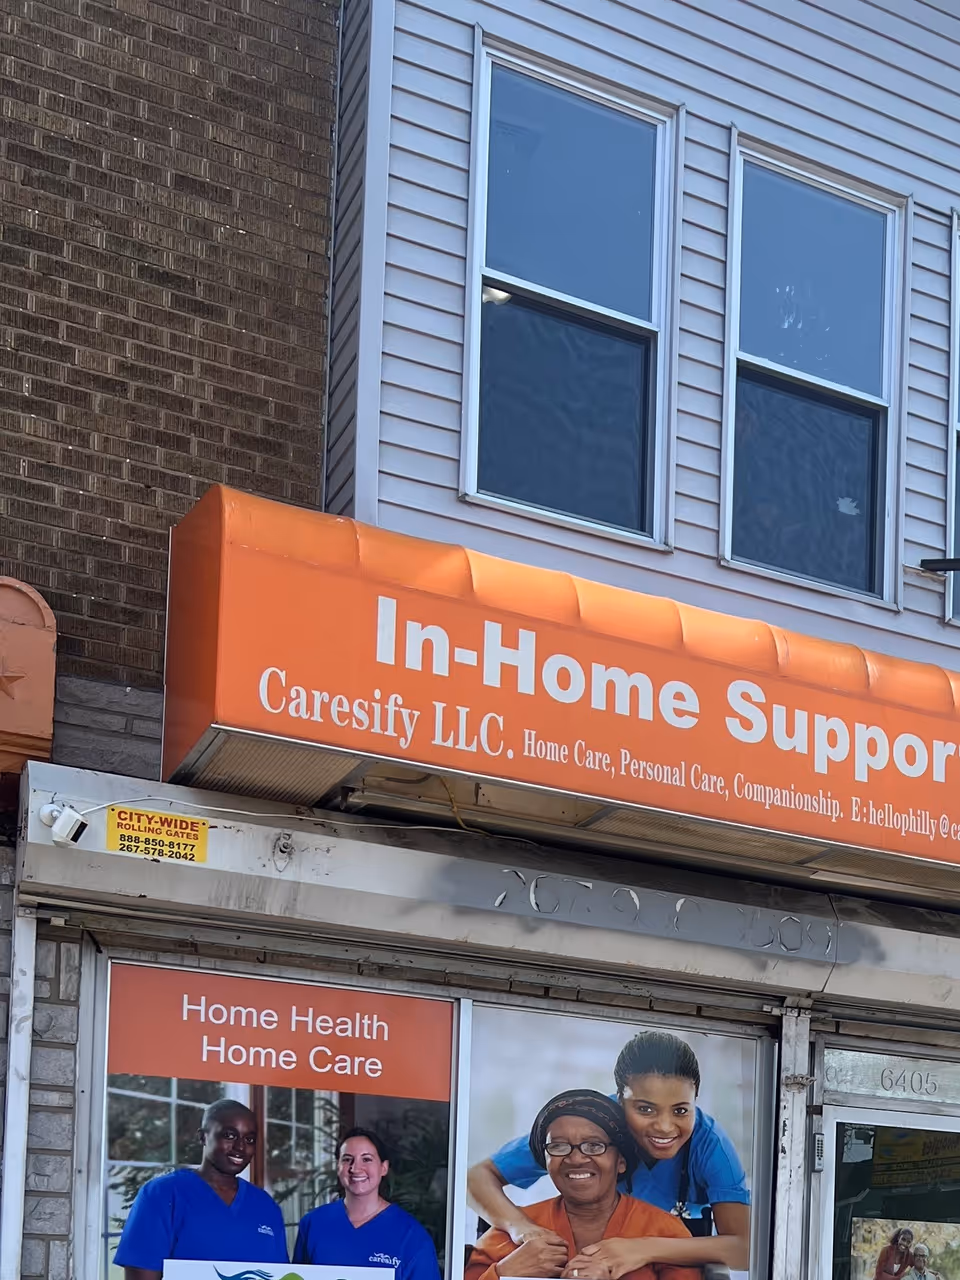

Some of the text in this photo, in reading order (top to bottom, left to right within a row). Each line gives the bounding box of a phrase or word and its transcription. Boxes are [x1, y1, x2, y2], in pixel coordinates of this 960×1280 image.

[375, 595, 700, 729] In-Home
[259, 667, 420, 749] Caresify
[431, 700, 514, 759] LLC.
[523, 729, 569, 764] Home
[573, 739, 616, 779] Care,
[619, 748, 686, 788] Personal
[690, 763, 729, 802] Care,
[733, 773, 844, 822] Companionship.
[116, 821, 199, 841] ROLLING GATES
[117, 810, 200, 832] CITY-WIDE
[119, 833, 196, 852] 888-850-8177
[119, 843, 196, 862] 267-578-2042
[182, 993, 389, 1041] Home Health
[202, 1035, 383, 1078] Home Care
[880, 1067, 938, 1097] 6405
